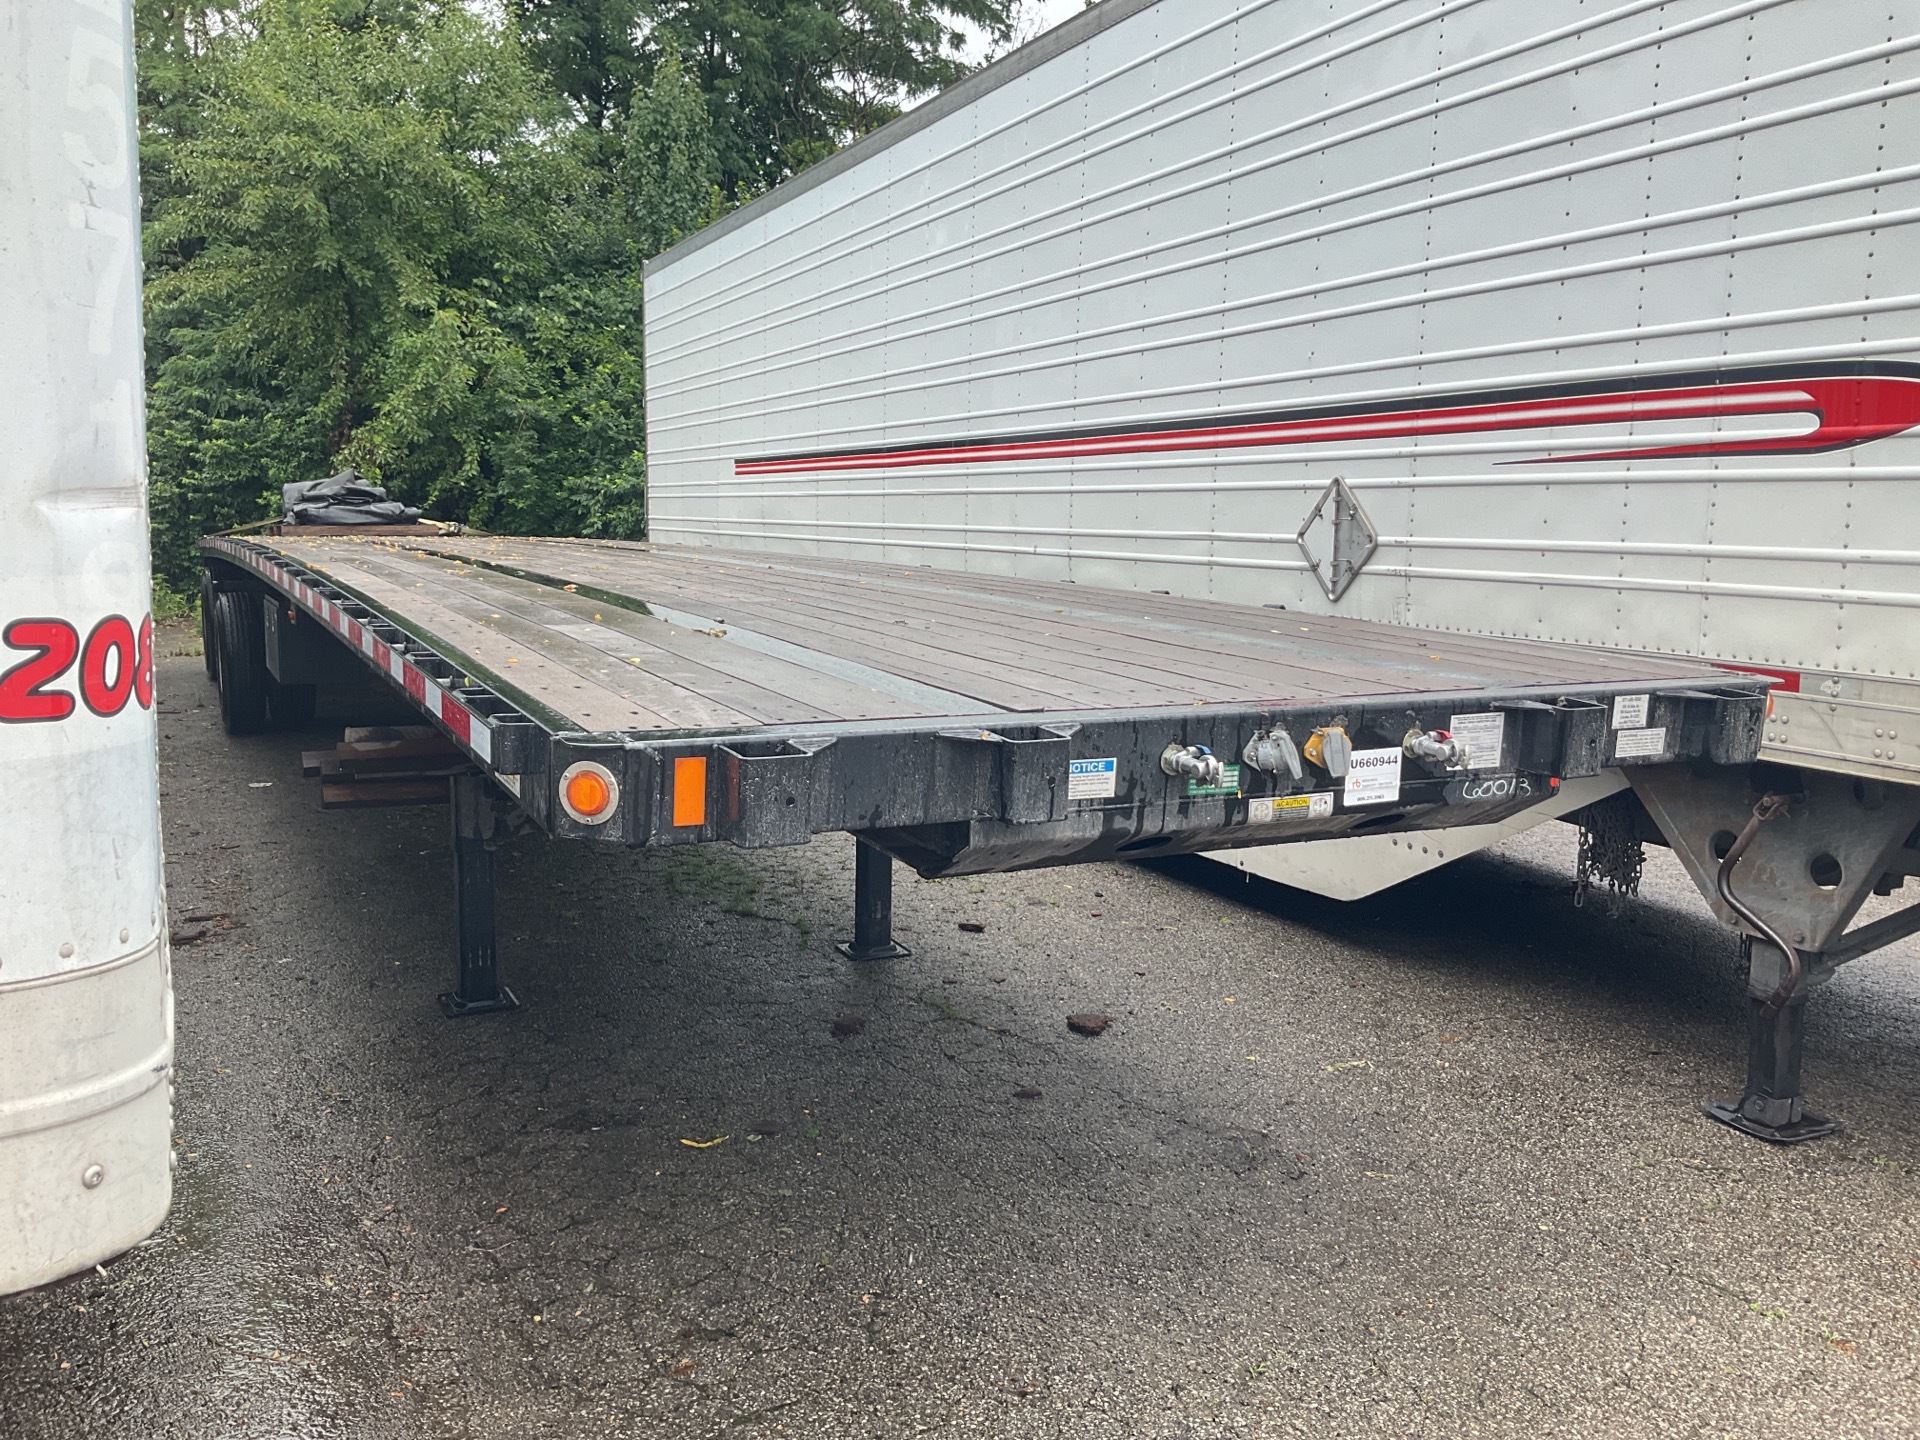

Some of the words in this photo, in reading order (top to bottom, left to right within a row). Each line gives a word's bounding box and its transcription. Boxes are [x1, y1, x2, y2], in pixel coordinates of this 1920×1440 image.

[1069, 762, 1106, 773] OTICE
[1350, 755, 1398, 769] U660944
[1463, 778, 1531, 799] 60013
[1280, 799, 1308, 807] CAUTION
